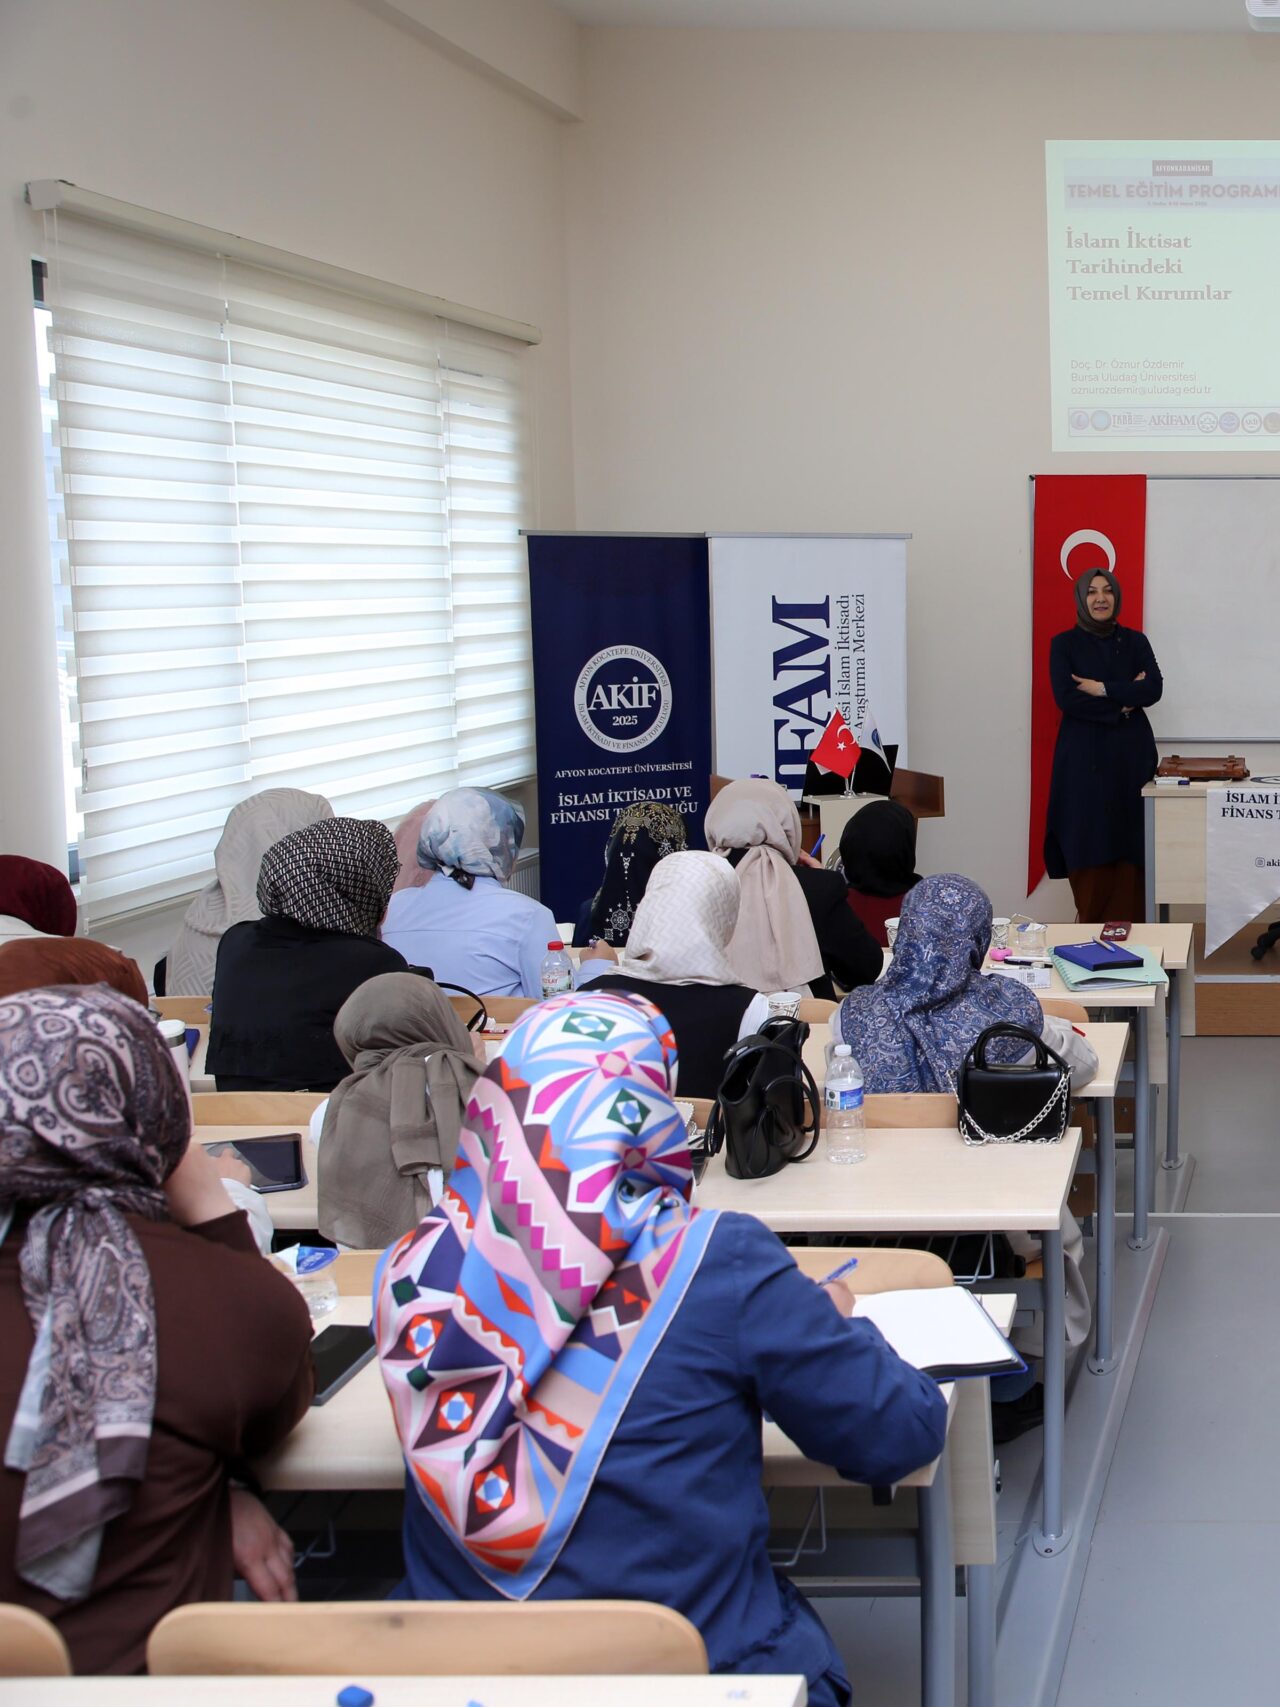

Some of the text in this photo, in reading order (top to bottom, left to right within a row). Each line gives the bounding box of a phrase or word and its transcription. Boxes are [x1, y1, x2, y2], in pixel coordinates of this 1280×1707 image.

[1067, 184, 1121, 198] TEMEL
[1125, 180, 1184, 198] EĞİTİM
[1066, 226, 1192, 249] İslam İktisat
[1066, 258, 1184, 275] Tarihindeki
[1066, 284, 1233, 301] Temel Kurumlar
[1071, 372, 1100, 382] Bursa
[1139, 370, 1197, 382] Üniversitesi
[1148, 412, 1197, 426] AKİFAM
[834, 594, 850, 651] İktisadı
[851, 593, 866, 653] Merkezi
[592, 647, 630, 667] KOCATEPE
[630, 647, 670, 688] ÜNİVERSİTESİ
[834, 655, 851, 696] İslam
[587, 676, 660, 711] AKİF
[612, 715, 638, 726] 2025
[612, 741, 621, 750] VE
[555, 761, 693, 779] AFYON KOCATEPE ÜNİVERSİTESİ
[558, 785, 692, 807] İSLAM İKTİSADI VE
[1226, 790, 1270, 806] İSLAM
[550, 808, 611, 825] FİNANSI
[1221, 805, 1273, 820] FİNANS
